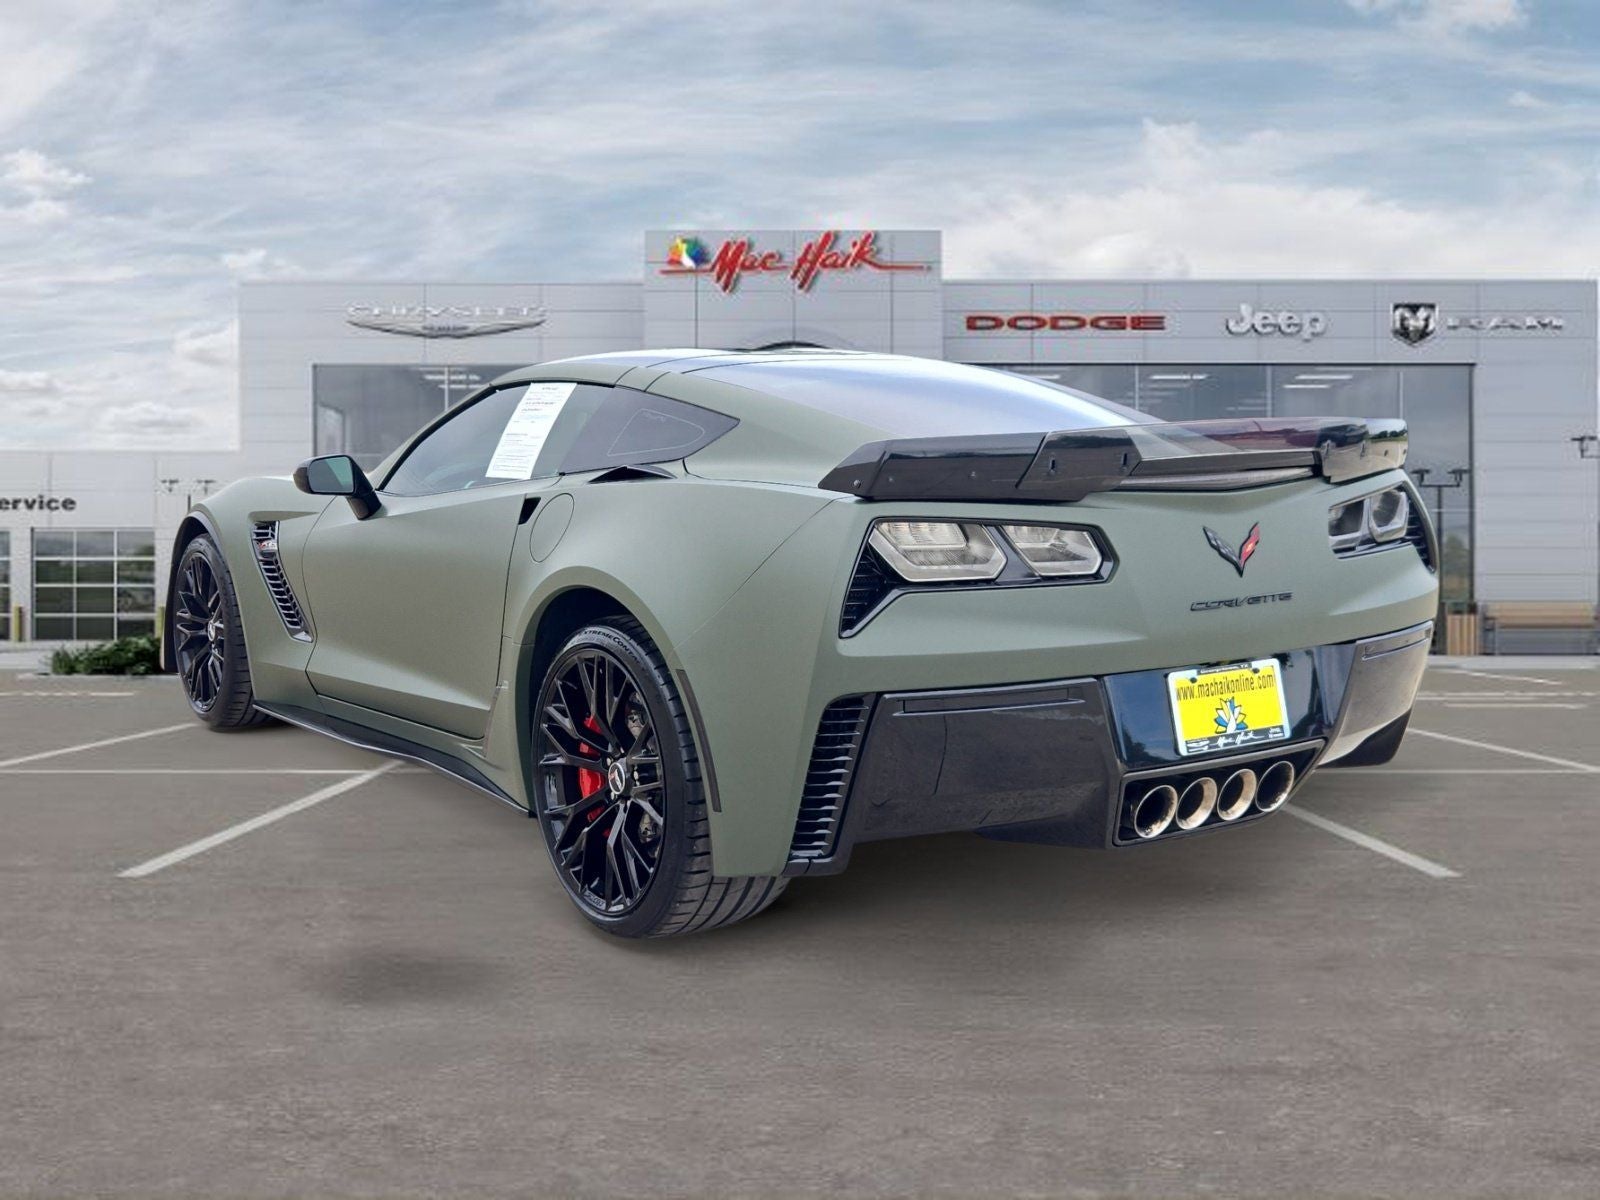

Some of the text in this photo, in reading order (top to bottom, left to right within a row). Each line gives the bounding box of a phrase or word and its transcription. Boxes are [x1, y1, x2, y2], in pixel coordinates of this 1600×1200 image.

[709, 229, 880, 293] Mac Haik
[965, 314, 1167, 331] DODGE
[1225, 303, 1327, 341] Jeep
[1190, 592, 1293, 611] CORVETTE
[1176, 674, 1274, 700] www.machaikonline.com
